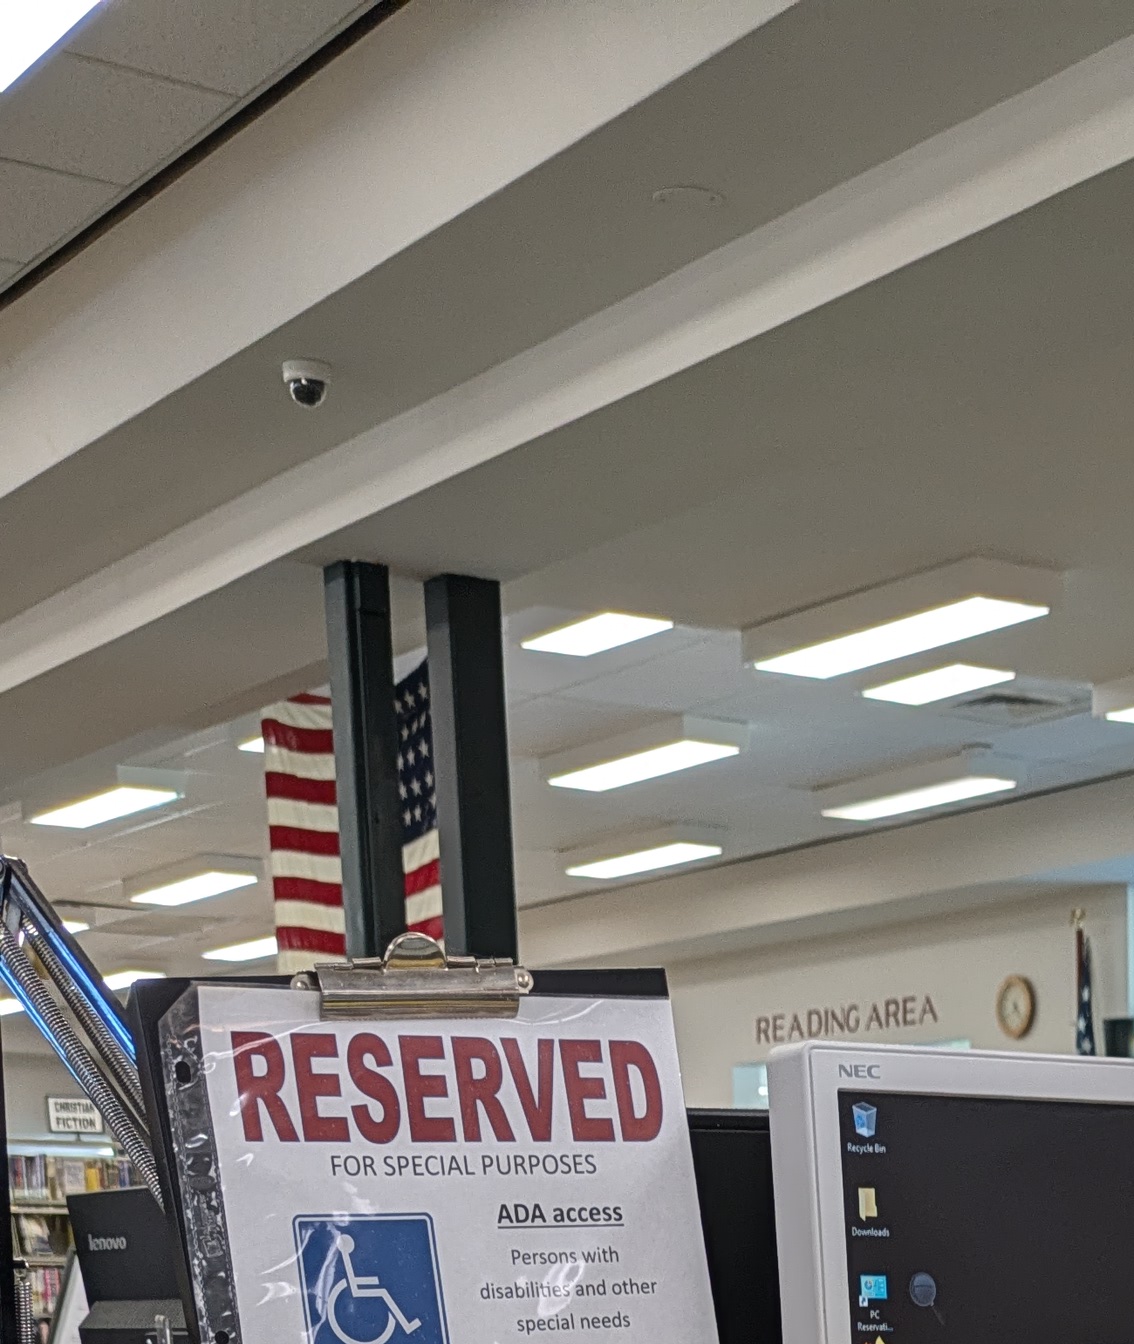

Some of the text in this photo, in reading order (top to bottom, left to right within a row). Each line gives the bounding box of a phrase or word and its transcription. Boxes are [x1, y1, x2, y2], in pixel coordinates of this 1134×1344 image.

[755, 994, 938, 1044] READING AREA
[838, 1063, 881, 1079] NEC
[230, 1030, 663, 1145] RESERVED
[56, 1116, 96, 1130] FICTION
[847, 1142, 886, 1154] Recycle Bin
[330, 1153, 597, 1177] FOR SPECIAL PURPOSES
[497, 1203, 623, 1224] ADA access
[852, 1226, 890, 1237] Downloads
[87, 1233, 127, 1251] lenovo
[511, 1246, 620, 1265] Persons with
[479, 1278, 657, 1300] disabilities and other
[516, 1311, 631, 1335] special needs
[869, 1309, 880, 1320] PC
